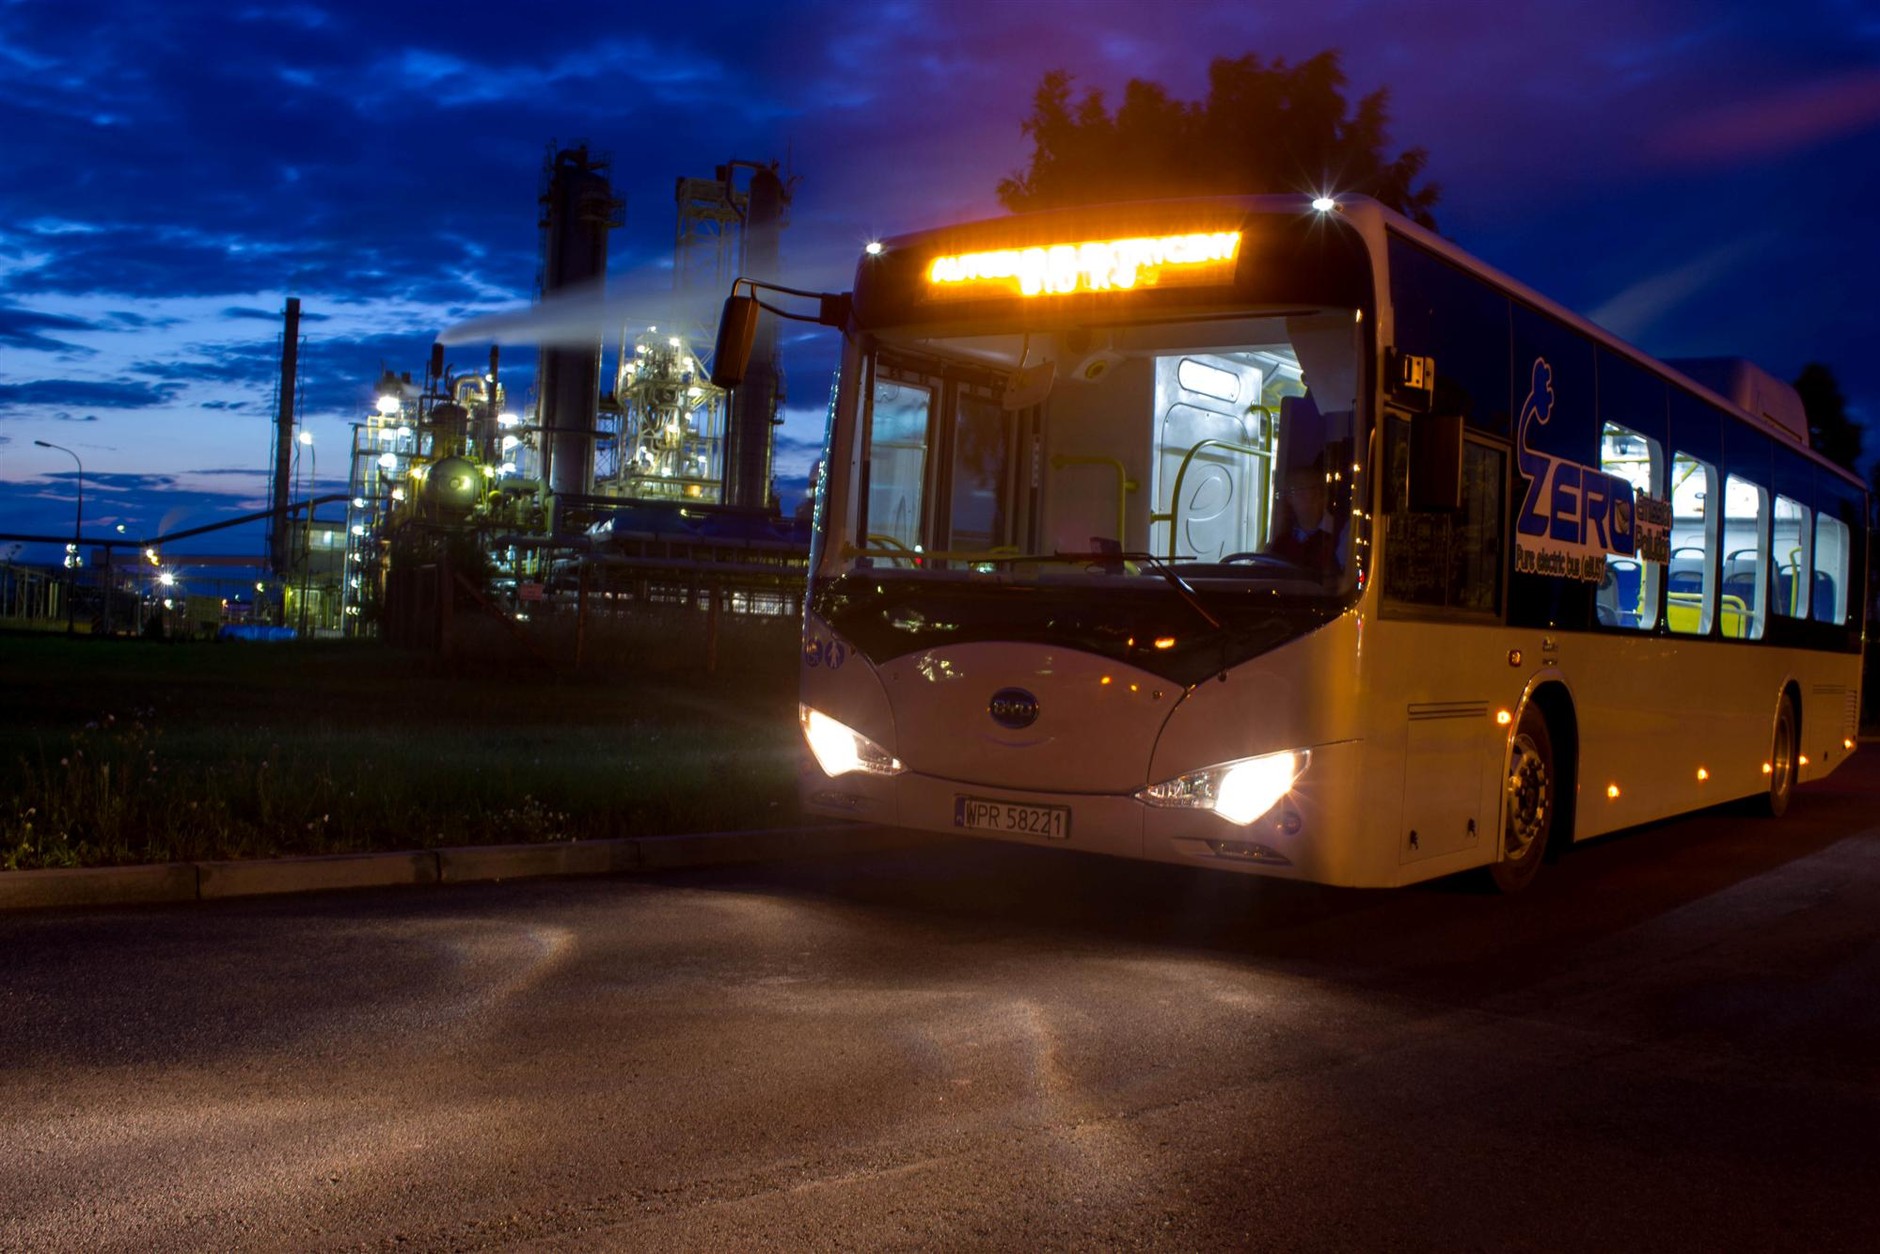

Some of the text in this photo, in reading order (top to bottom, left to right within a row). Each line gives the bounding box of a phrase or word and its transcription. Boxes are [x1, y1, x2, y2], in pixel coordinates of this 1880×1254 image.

[1517, 450, 1636, 554] ZERO
[966, 802, 1061, 836] WPR 58221
